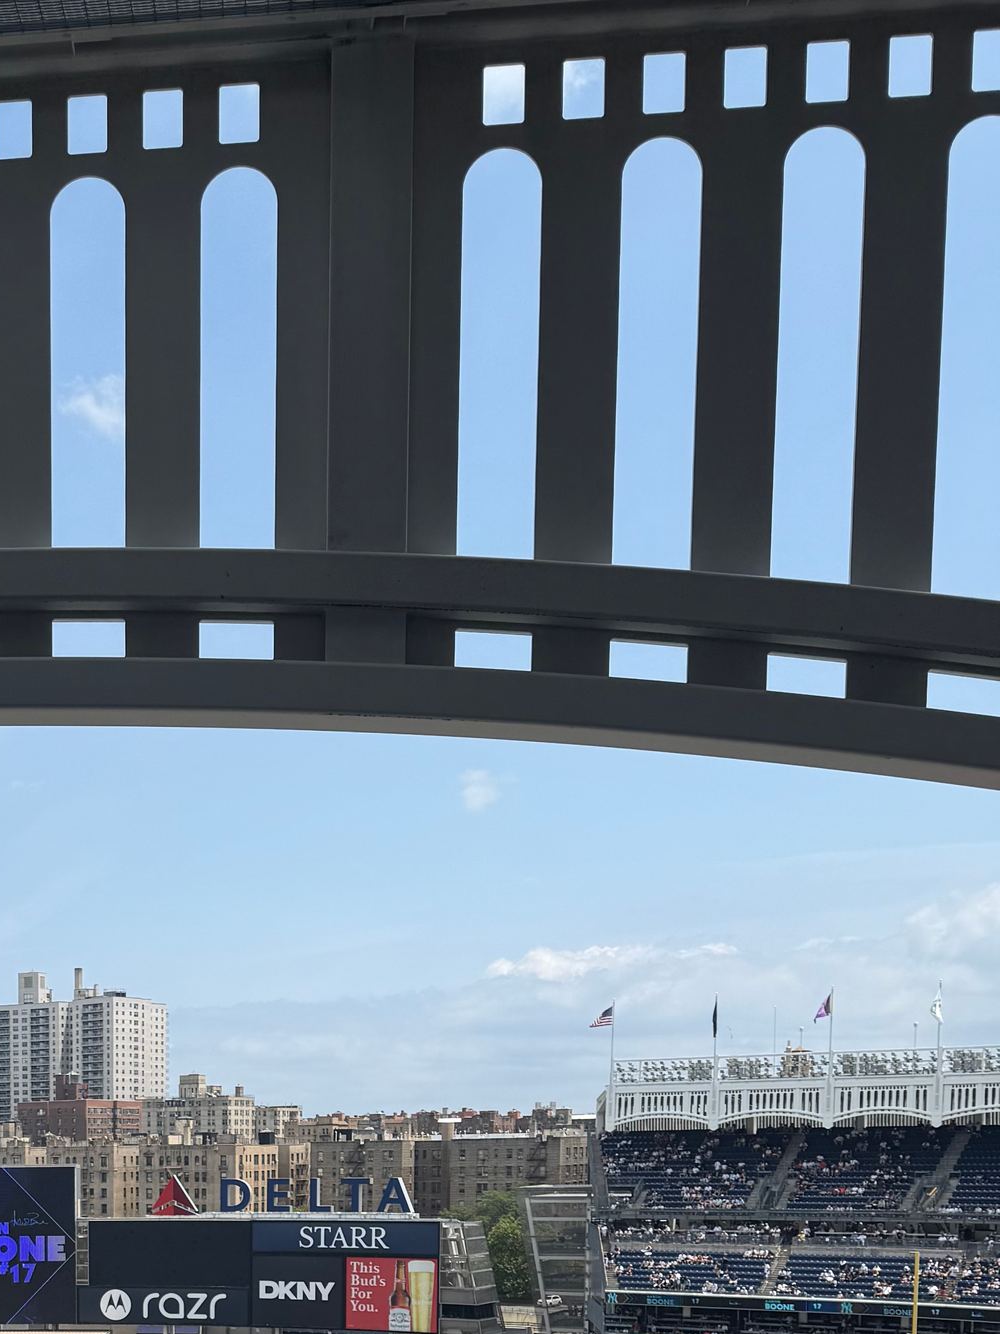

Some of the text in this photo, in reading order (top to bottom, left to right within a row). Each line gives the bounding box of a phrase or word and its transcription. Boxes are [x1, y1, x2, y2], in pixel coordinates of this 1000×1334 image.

[220, 1177, 415, 1213] DELTA
[298, 1226, 390, 1249] STARR
[350, 1262, 380, 1273] This
[350, 1274, 386, 1287] Bud's
[259, 1280, 335, 1301] DKNY
[350, 1288, 373, 1299] For
[143, 1293, 228, 1319] razr
[350, 1300, 379, 1312] You.
[765, 1303, 795, 1311] BOONE
